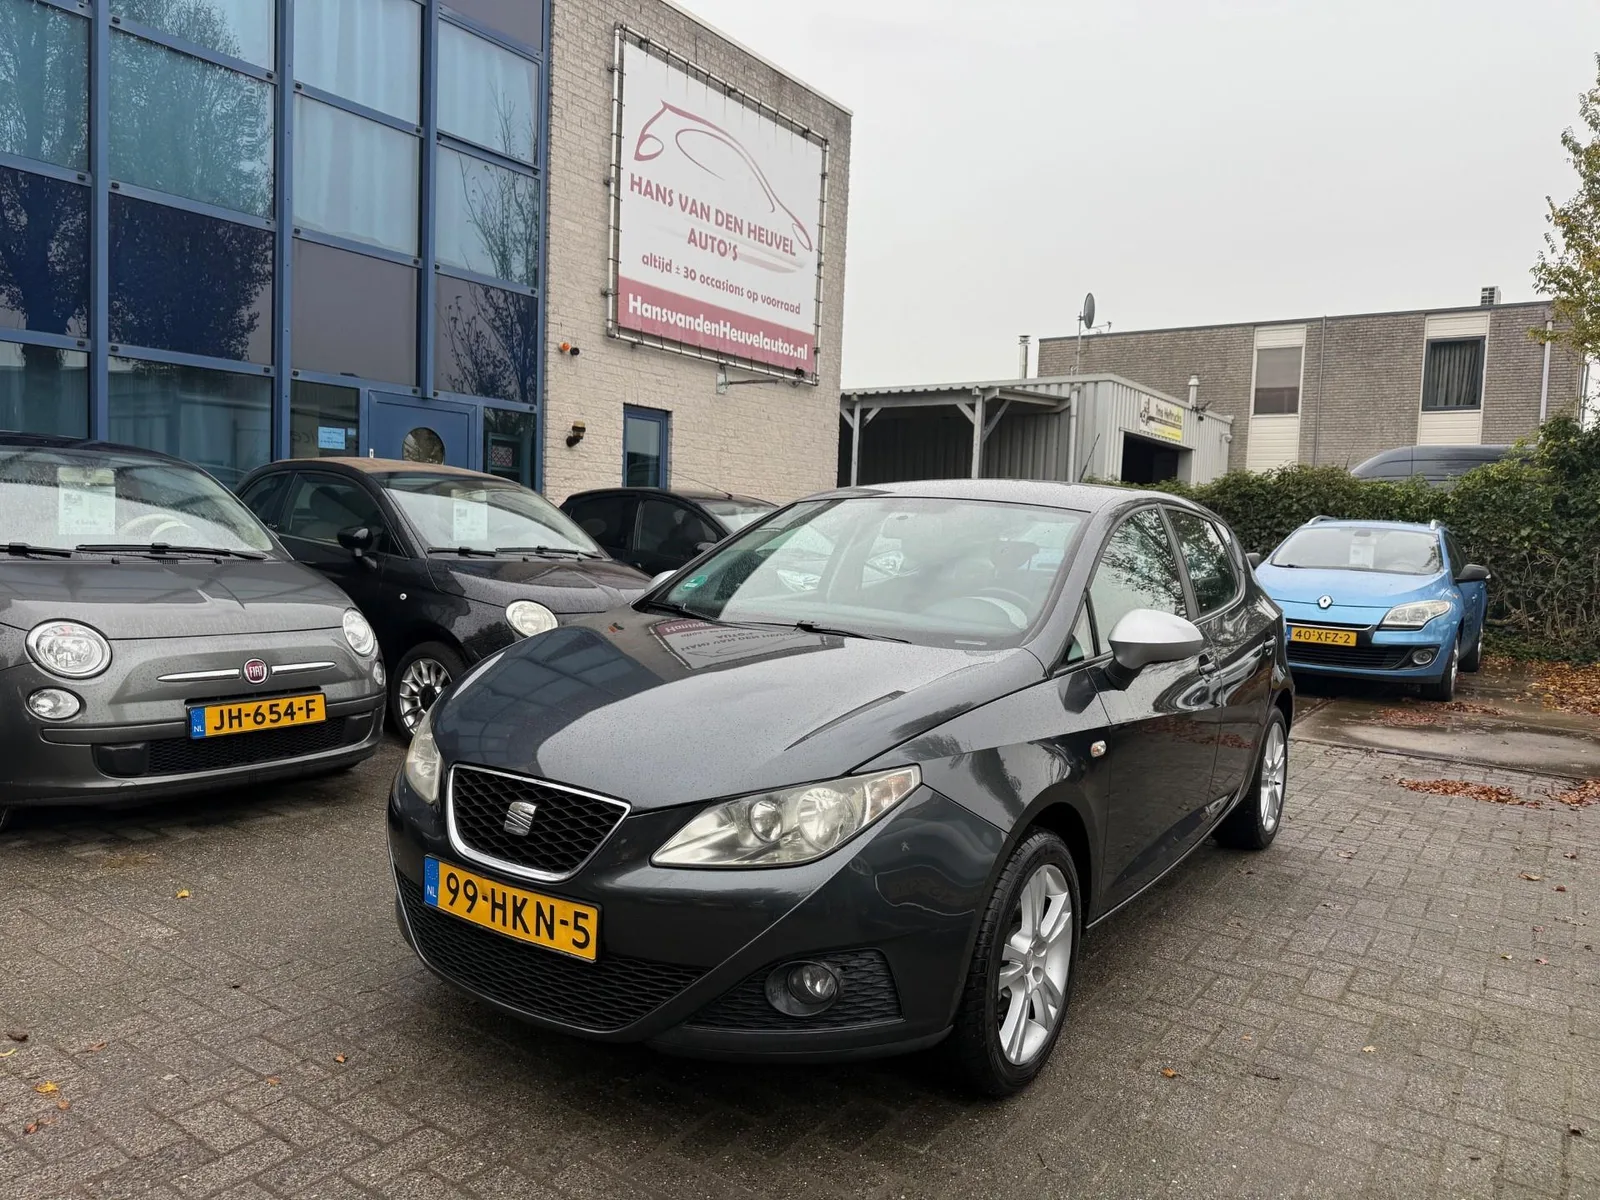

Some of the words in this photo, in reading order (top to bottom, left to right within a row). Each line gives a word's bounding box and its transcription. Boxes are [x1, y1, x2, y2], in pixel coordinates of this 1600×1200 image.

[630, 173, 674, 207] HANS
[679, 193, 710, 222] VAN
[715, 208, 743, 236] DEN
[747, 221, 796, 257] HEUVEL
[687, 228, 738, 261] AUTO'S
[642, 252, 672, 273] altijd
[683, 266, 697, 281] 30
[700, 274, 744, 297] occasions
[747, 290, 758, 303] op
[761, 294, 800, 315] voorraad
[628, 293, 808, 360] HansvandenHeuvelautos.nl
[1295, 629, 1351, 644] 40-XFZ-2
[248, 665, 263, 678] FIAT
[193, 725, 204, 733] NL
[214, 699, 316, 731] JH-654-F
[427, 885, 436, 898] NL
[446, 872, 591, 950] 99-HKN-5
